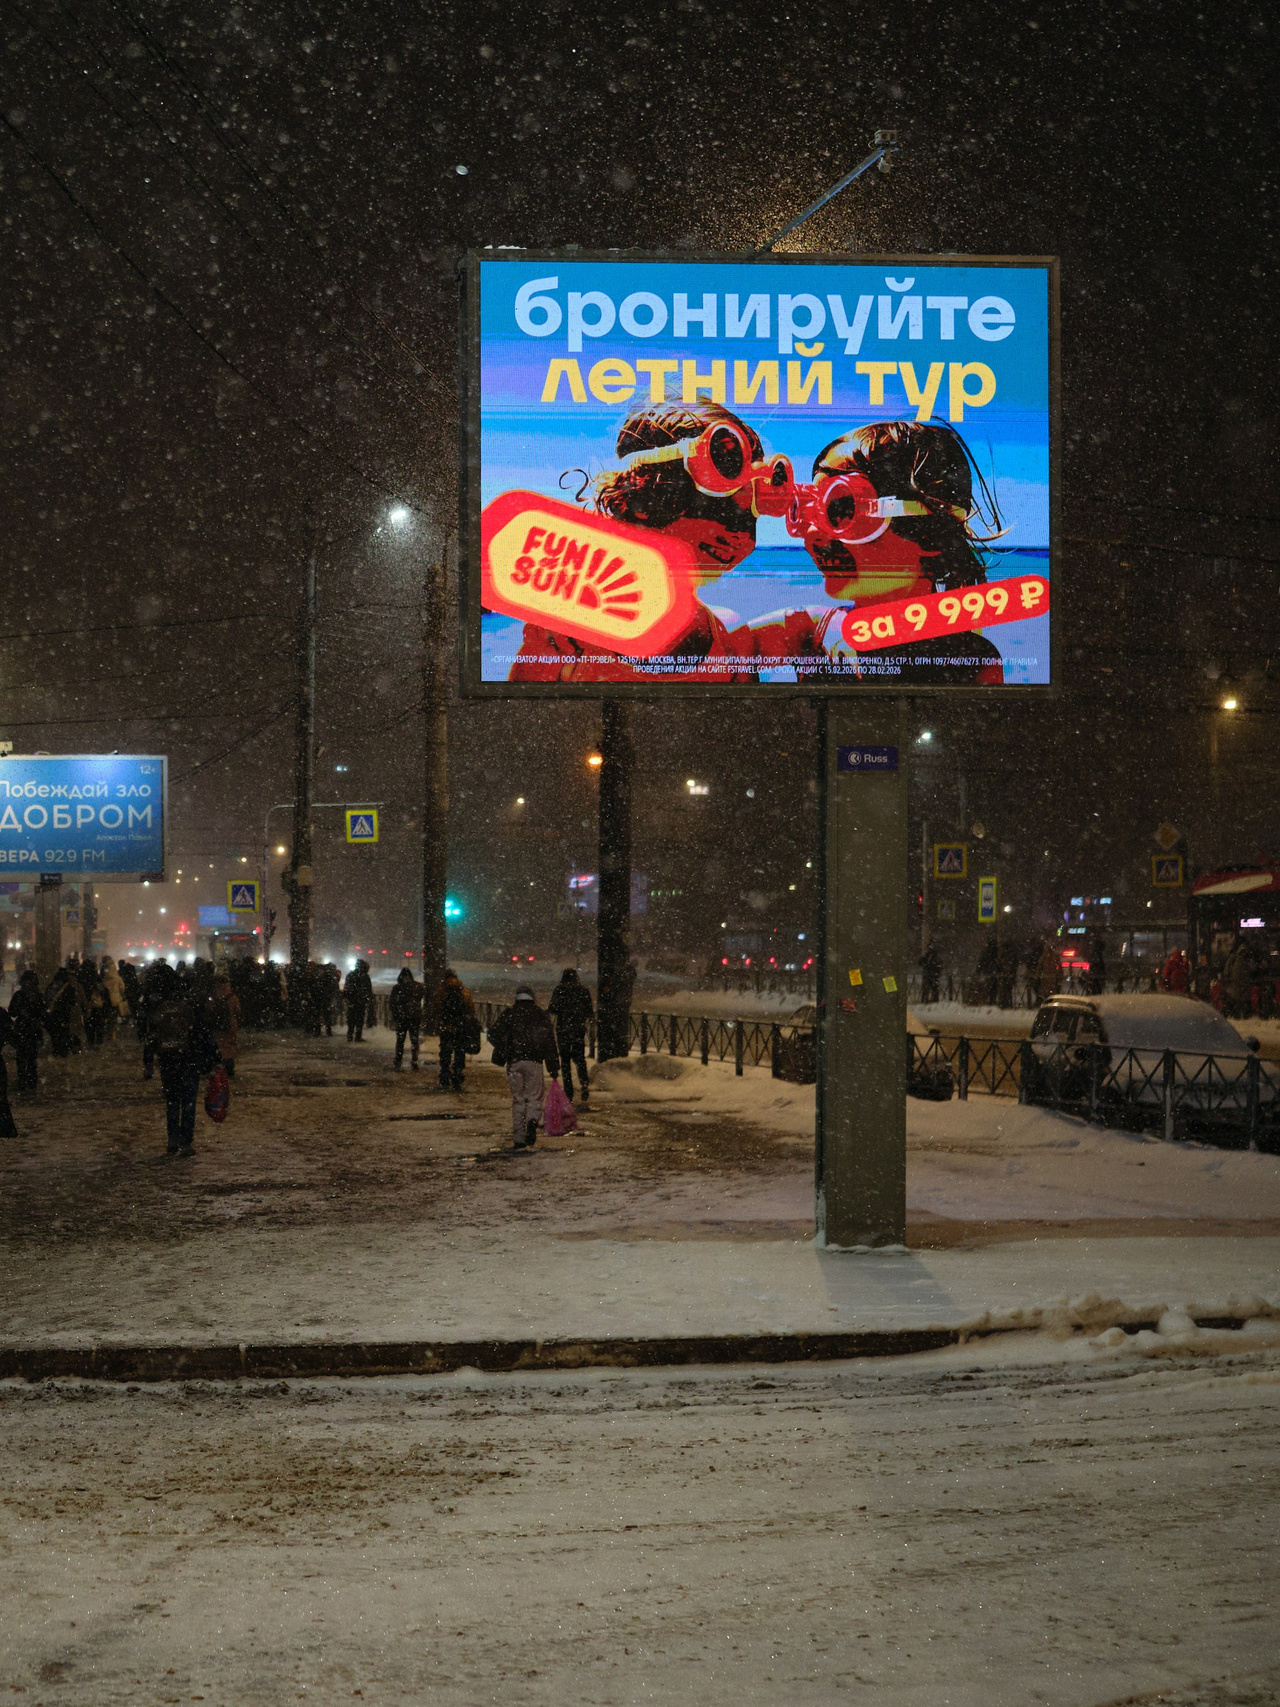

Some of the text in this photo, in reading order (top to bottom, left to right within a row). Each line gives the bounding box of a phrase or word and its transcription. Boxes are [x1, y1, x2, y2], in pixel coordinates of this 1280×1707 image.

[514, 275, 1016, 355] бронируйте
[540, 342, 997, 422] летний тур
[521, 525, 591, 571] FUN
[509, 555, 580, 601] SUN
[850, 581, 1044, 643] за 9 999 ₽
[538, 655, 560, 665] АКЦИИ
[561, 655, 576, 664] ООО
[648, 656, 676, 665] МОСКВА,
[763, 656, 782, 665] ОКРУГ
[782, 656, 831, 666] ХОРОШЕВСКИЙ,
[842, 657, 883, 666] ВИКТОРЕНКО,
[915, 657, 931, 665] ОГРН
[981, 657, 1008, 666] ПОЛНЫЕ
[1009, 657, 1038, 666] ПРАВИЛА
[633, 665, 674, 674] ПРОВЕДЕНИЯ
[675, 665, 697, 674] АКЦИИ
[697, 665, 707, 673] НА
[707, 664, 727, 674] САЙТЕ
[774, 666, 795, 674] СРОКИ
[795, 666, 818, 675] АКЦИИ
[824, 666, 857, 675] 15.02.2026
[857, 666, 868, 674] ПО
[868, 666, 901, 675] 28.02.2026
[863, 753, 888, 763] Russ
[139, 765, 156, 775] 12+
[115, 784, 152, 798] зло
[44, 850, 77, 863] 92.9
[82, 850, 106, 862] FM
